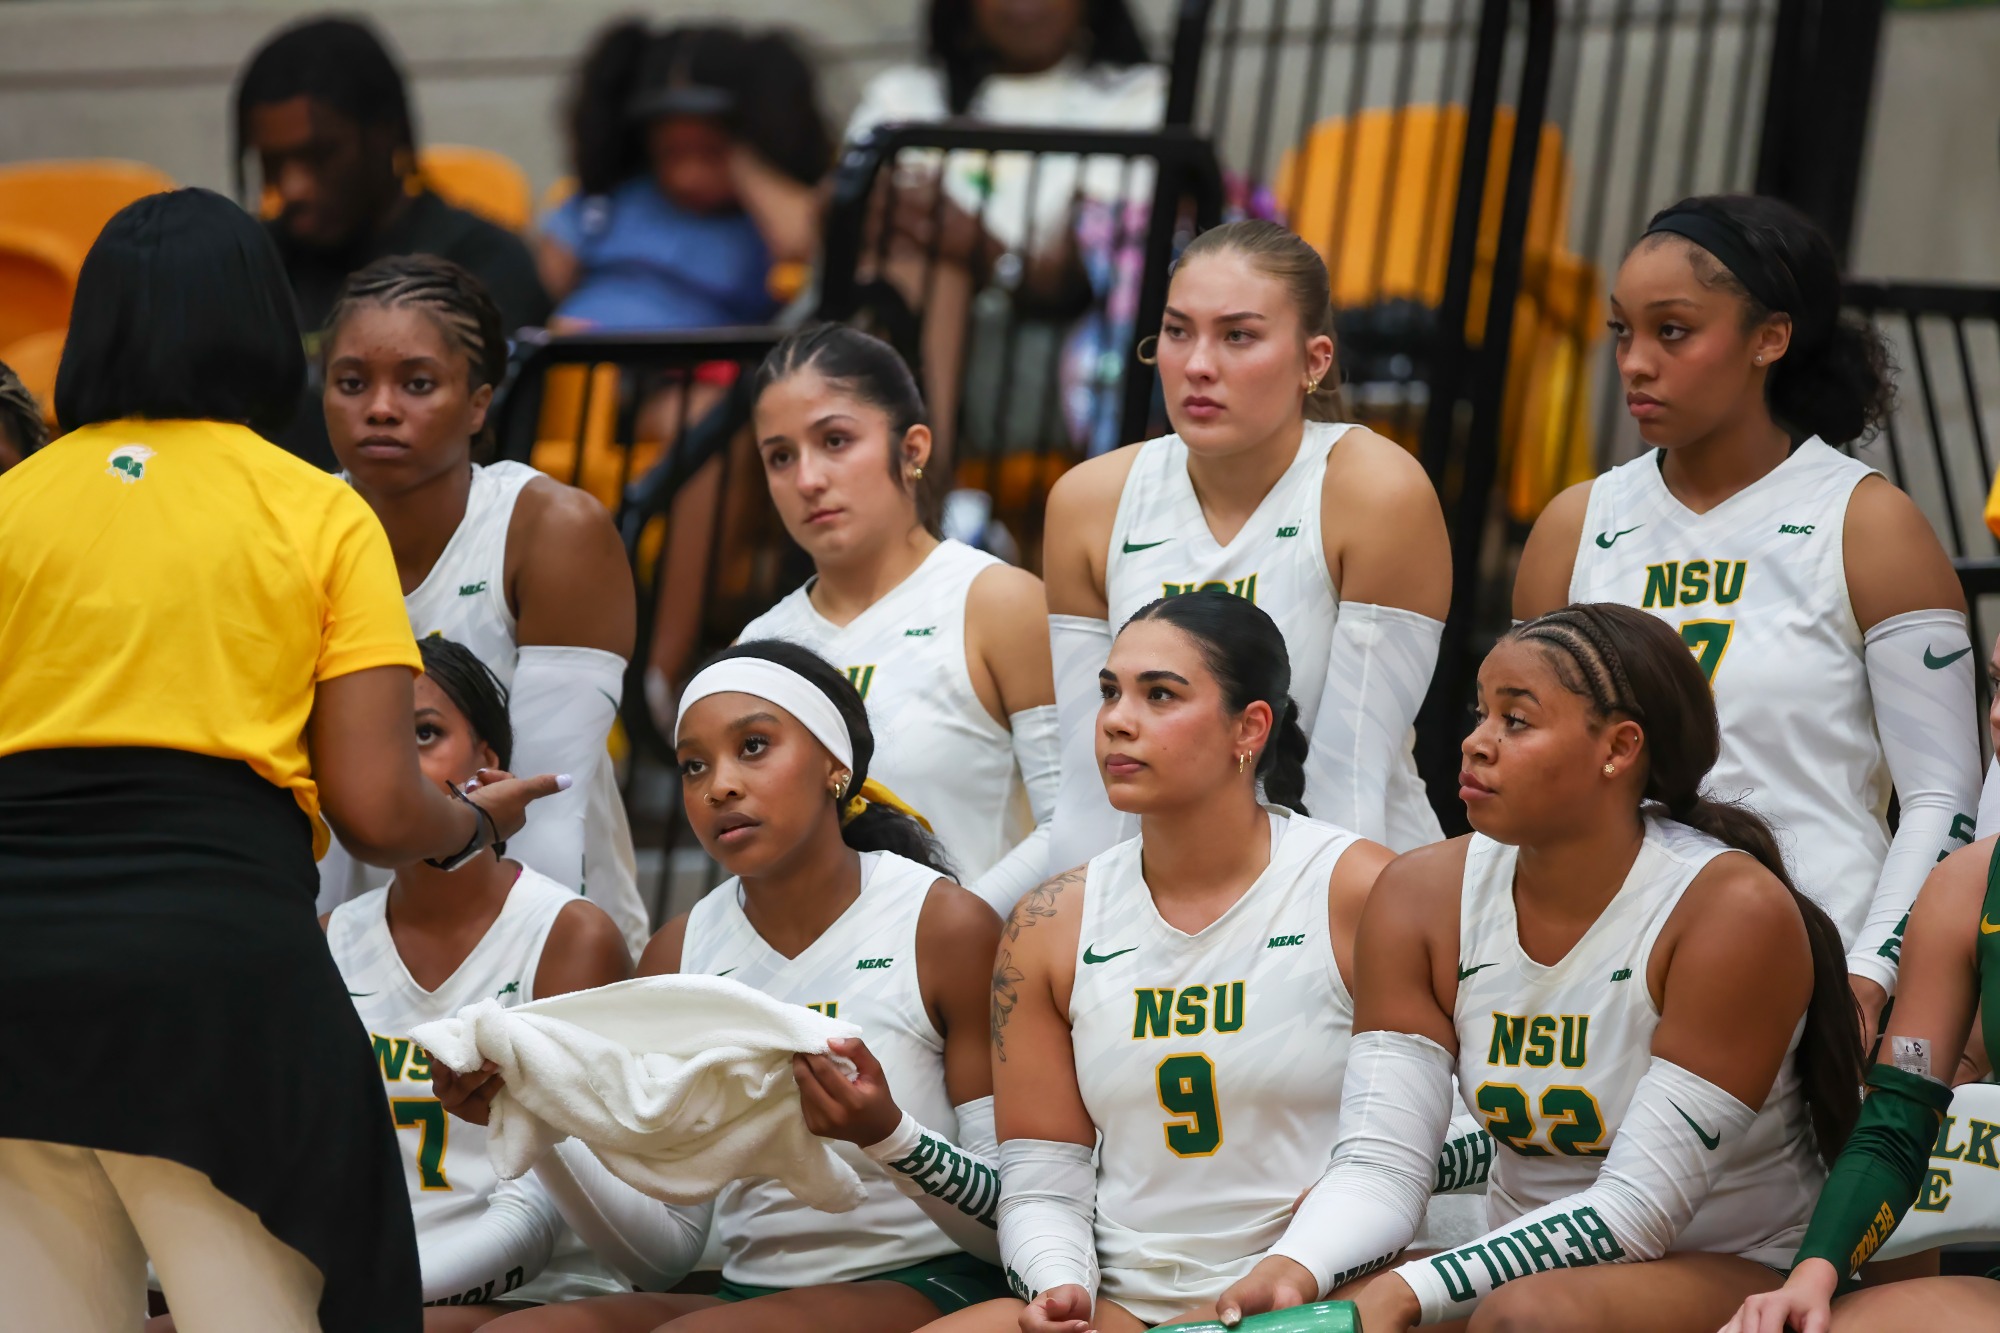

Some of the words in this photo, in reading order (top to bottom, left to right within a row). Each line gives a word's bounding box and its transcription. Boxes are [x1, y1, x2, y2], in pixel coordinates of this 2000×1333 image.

[1779, 524, 1816, 535] MEAC
[1642, 559, 1748, 609] NSU
[855, 958, 894, 970] MEAC
[1267, 933, 1306, 949] MEAC
[1132, 981, 1246, 1040] NSU
[370, 1033, 433, 1082] NS
[1488, 1011, 1590, 1069] NSU
[1155, 1051, 1223, 1160] 9
[1475, 1081, 1612, 1158] 22
[1430, 1206, 1626, 1303] BEHOLD
